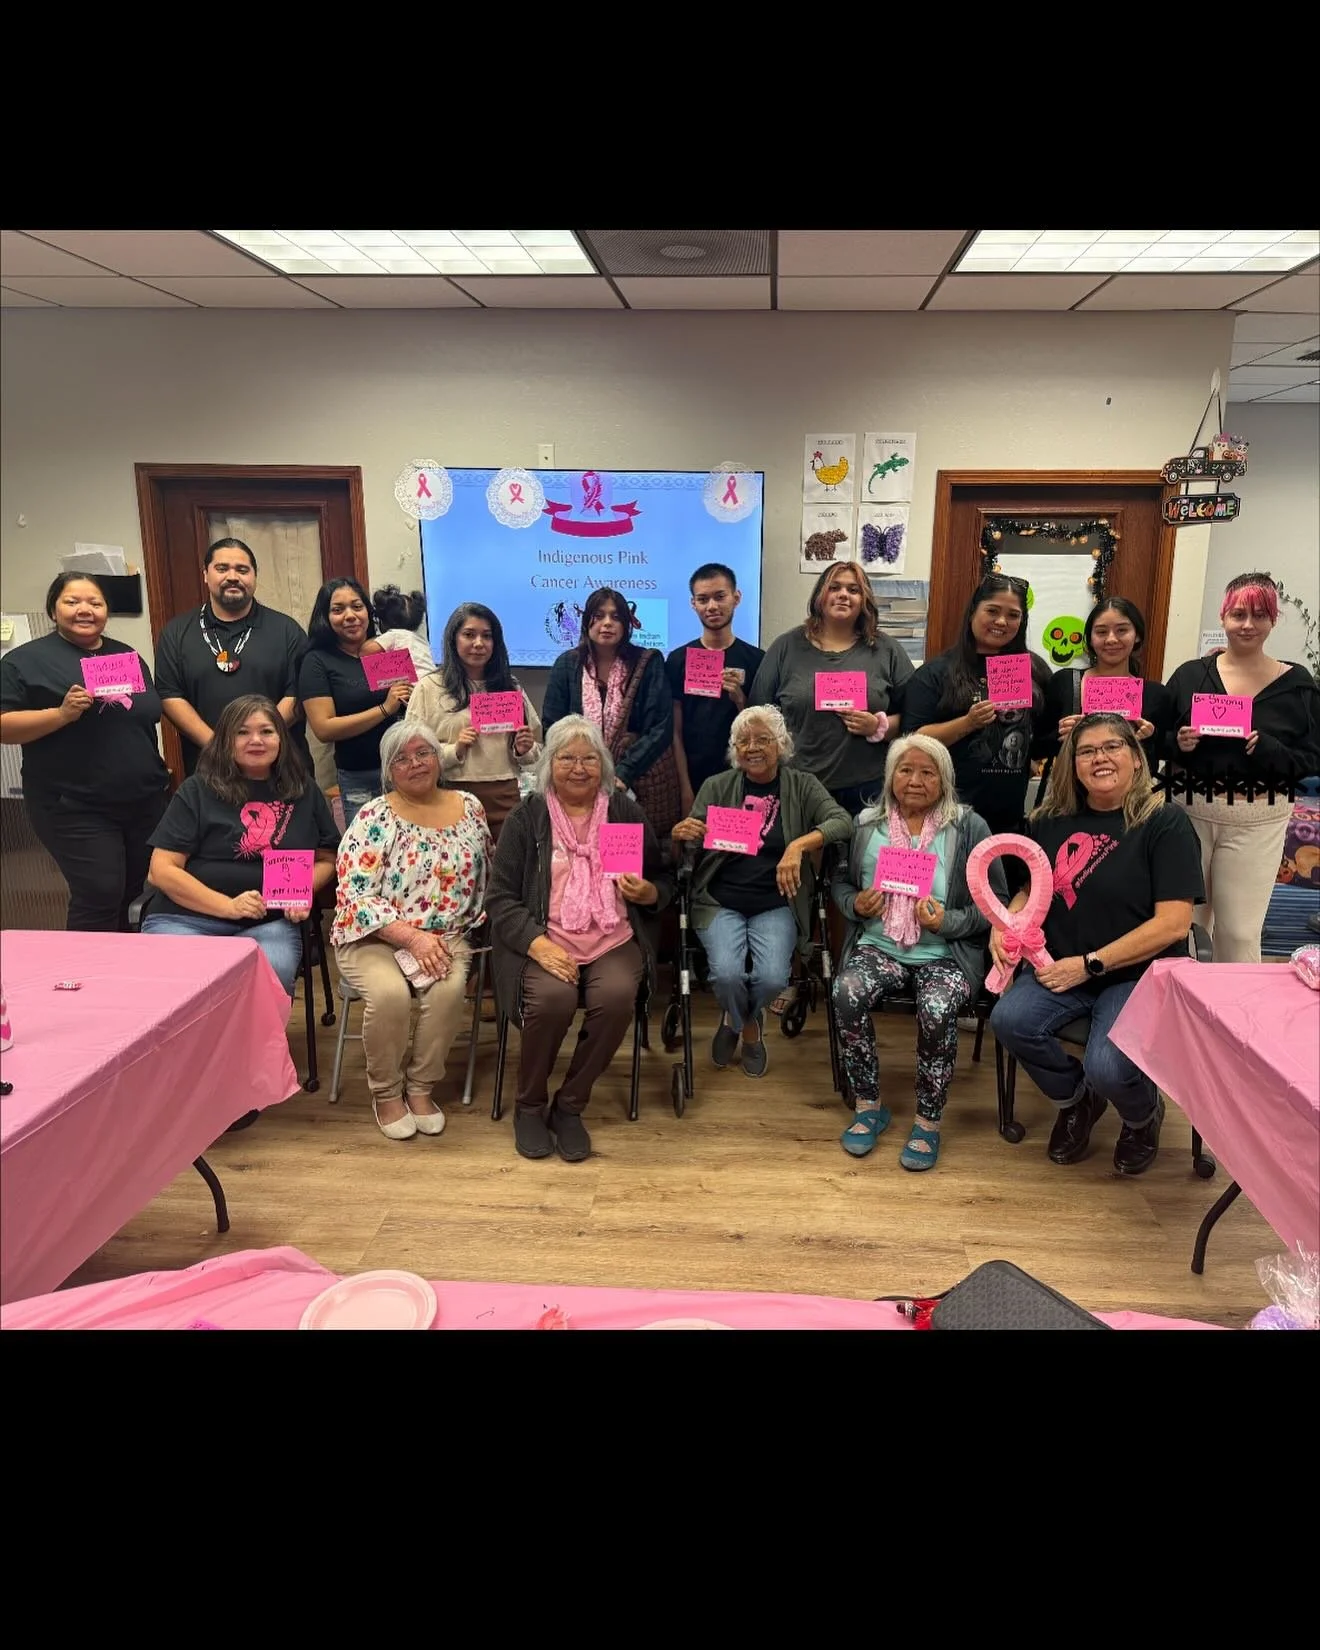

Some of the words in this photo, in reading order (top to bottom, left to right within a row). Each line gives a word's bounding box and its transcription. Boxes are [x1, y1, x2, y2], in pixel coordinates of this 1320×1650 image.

[538, 550, 613, 567] Indigenous
[618, 550, 649, 565] Pink
[530, 574, 578, 589] Cancer
[583, 575, 657, 590] Awareness
